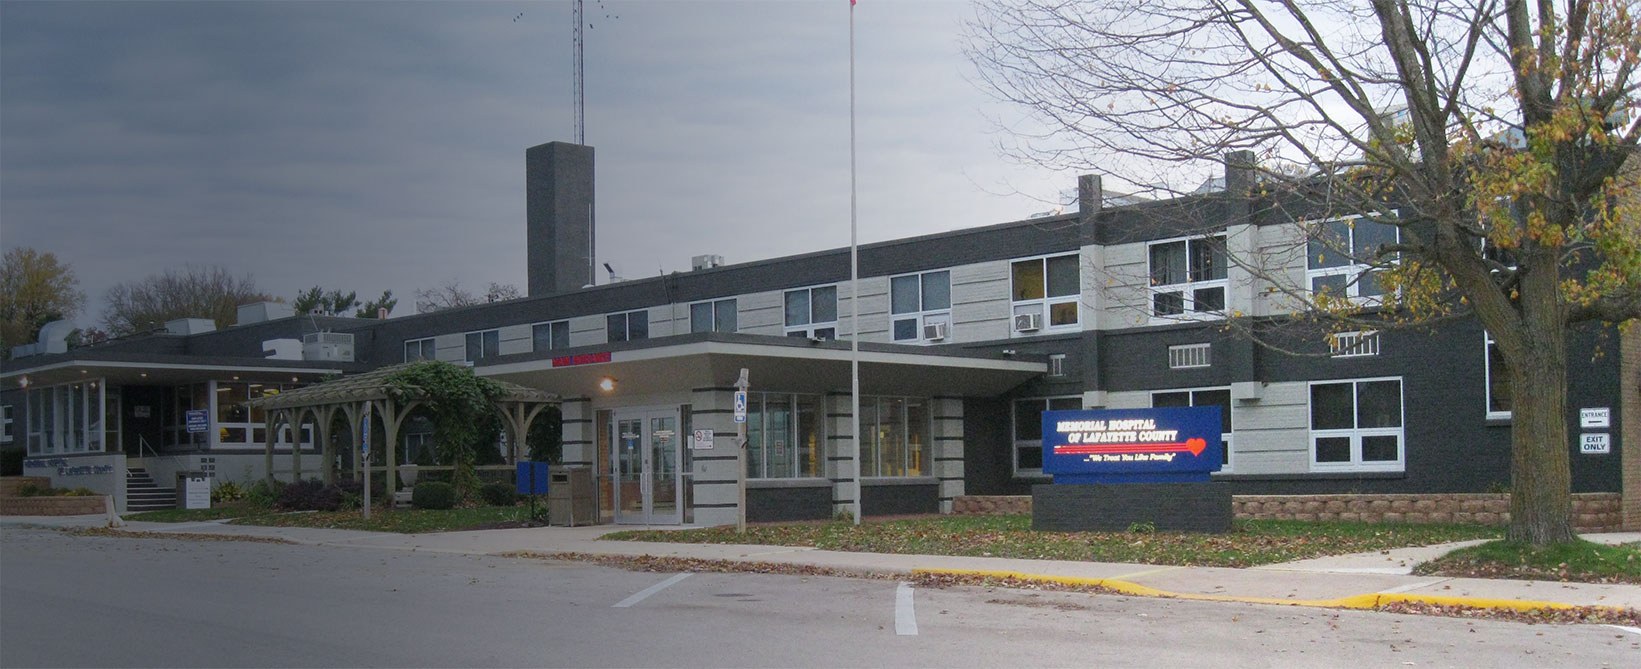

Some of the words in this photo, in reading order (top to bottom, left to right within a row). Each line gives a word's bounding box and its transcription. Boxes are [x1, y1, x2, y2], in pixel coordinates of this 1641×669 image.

[1056, 420, 1107, 432] MEMORIAL
[1108, 419, 1156, 431] HOSPITAL
[1068, 432, 1082, 443] OF
[1082, 430, 1137, 443] LAFAYETTE
[1138, 430, 1178, 442] COUNTY
[1584, 443, 1606, 451] ONLY
[1103, 454, 1121, 462] Treat
[1121, 453, 1134, 462] You
[1134, 453, 1150, 461] Like
